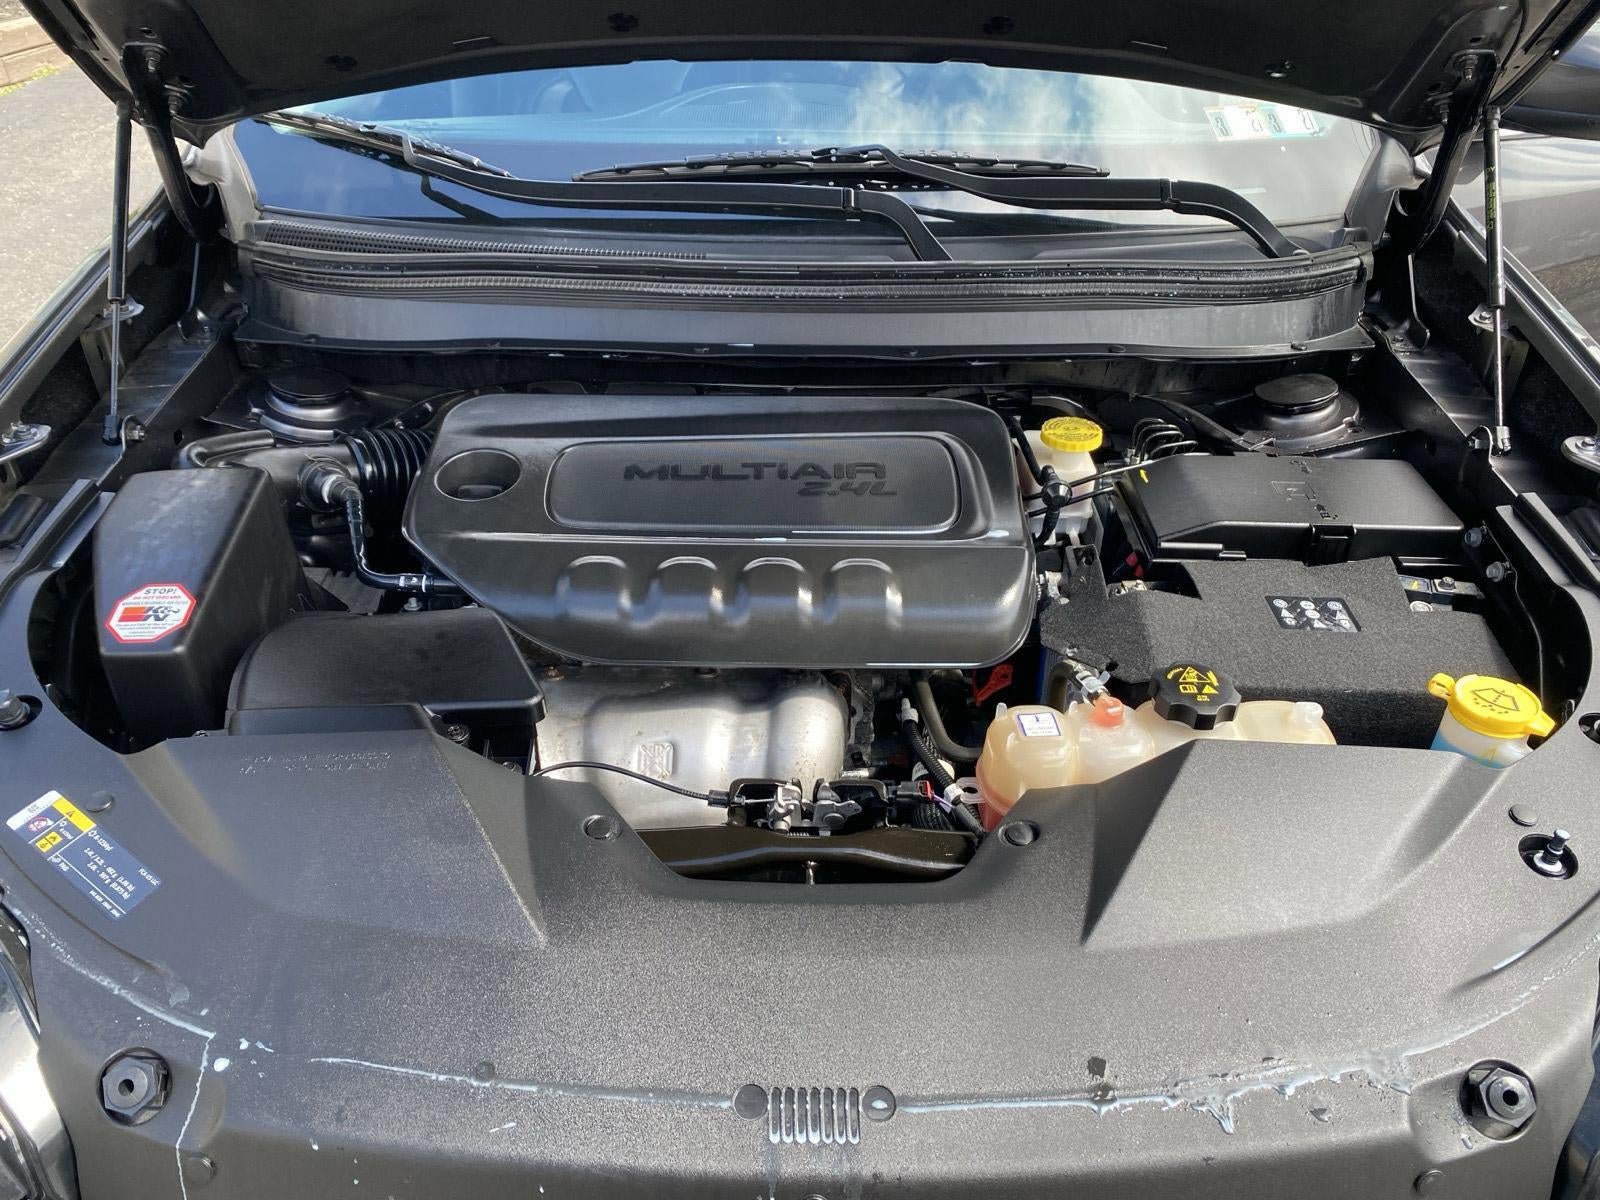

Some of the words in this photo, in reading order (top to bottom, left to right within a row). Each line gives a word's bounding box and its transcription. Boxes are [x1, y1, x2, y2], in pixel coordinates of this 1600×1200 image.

[1267, 113, 1282, 133] 3
[623, 462, 887, 480] MULTIAIR
[798, 481, 897, 496] 2.4L
